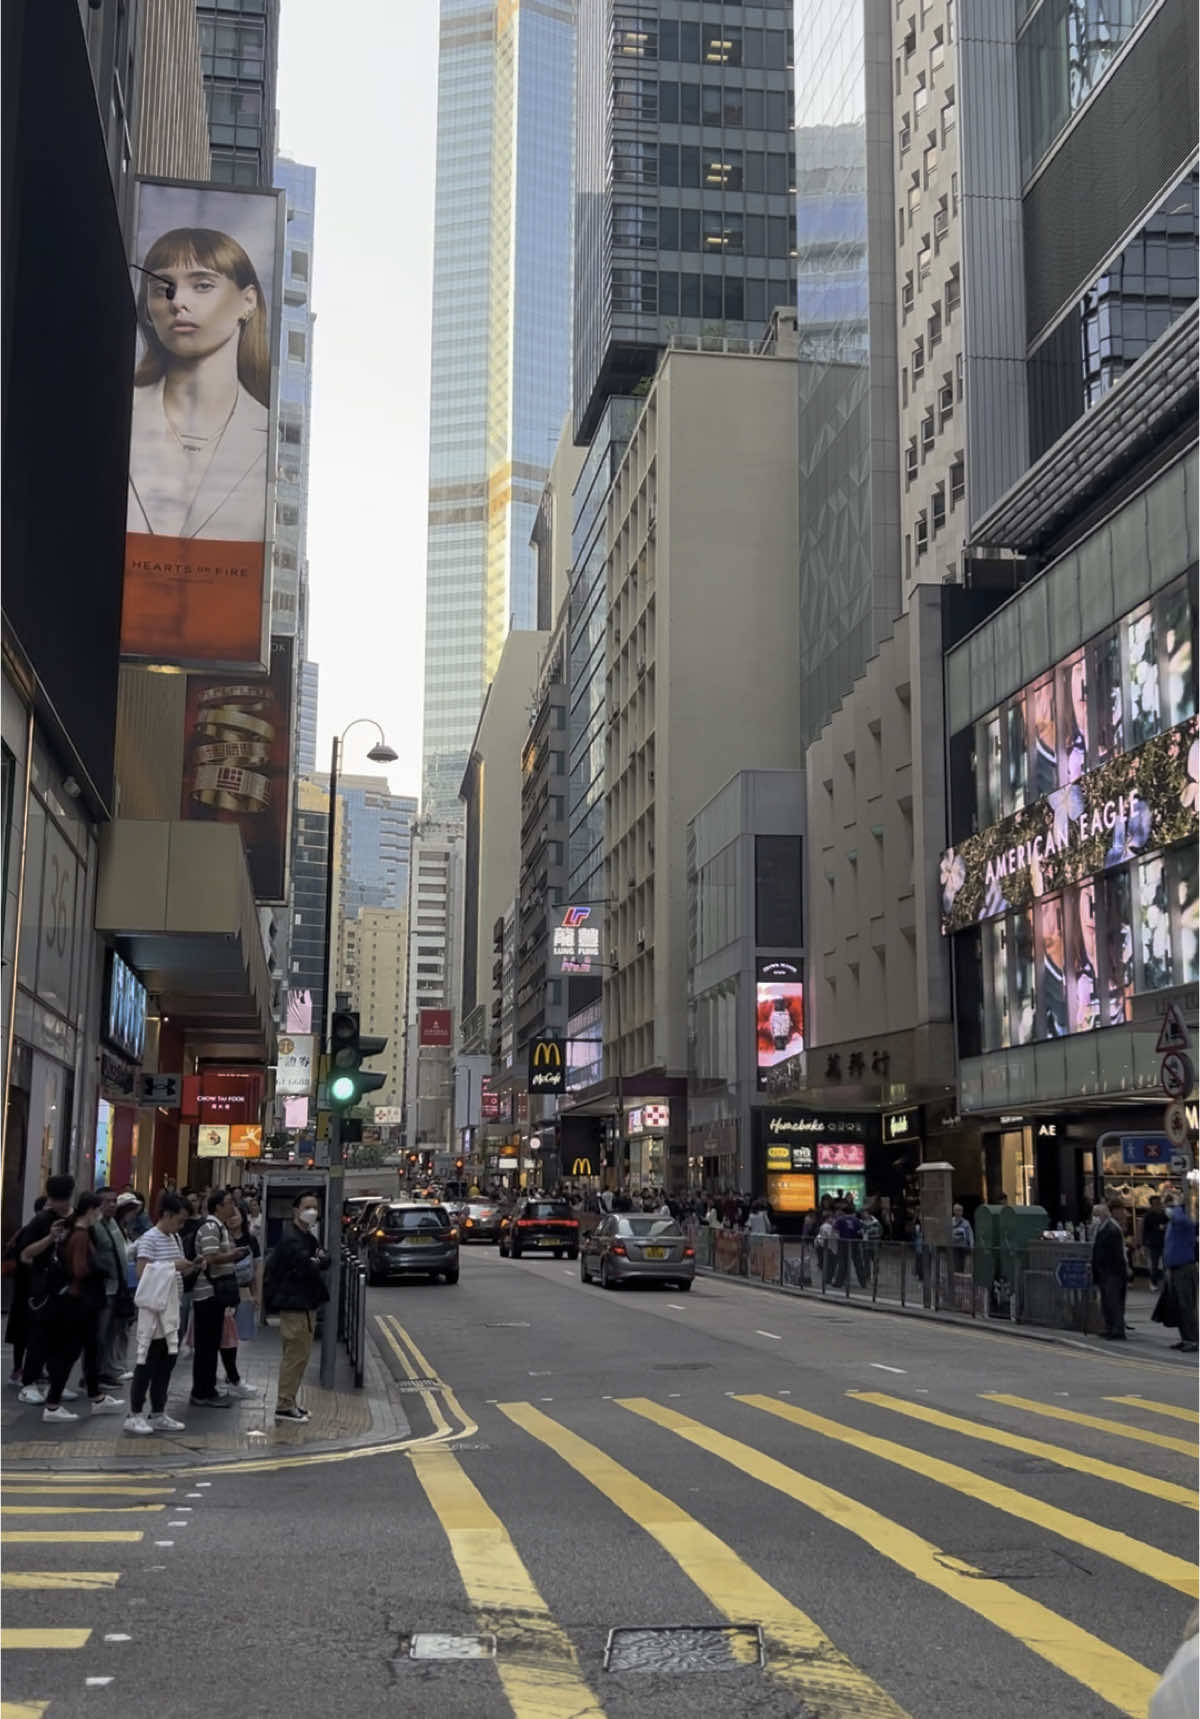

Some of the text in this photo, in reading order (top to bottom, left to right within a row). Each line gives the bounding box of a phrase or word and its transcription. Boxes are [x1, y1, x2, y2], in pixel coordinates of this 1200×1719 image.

[132, 560, 192, 574] HEARTS
[215, 567, 248, 577] FIRE
[985, 788, 1140, 885] AMERICAN EAGLE
[1039, 1124, 1057, 1135] AE
